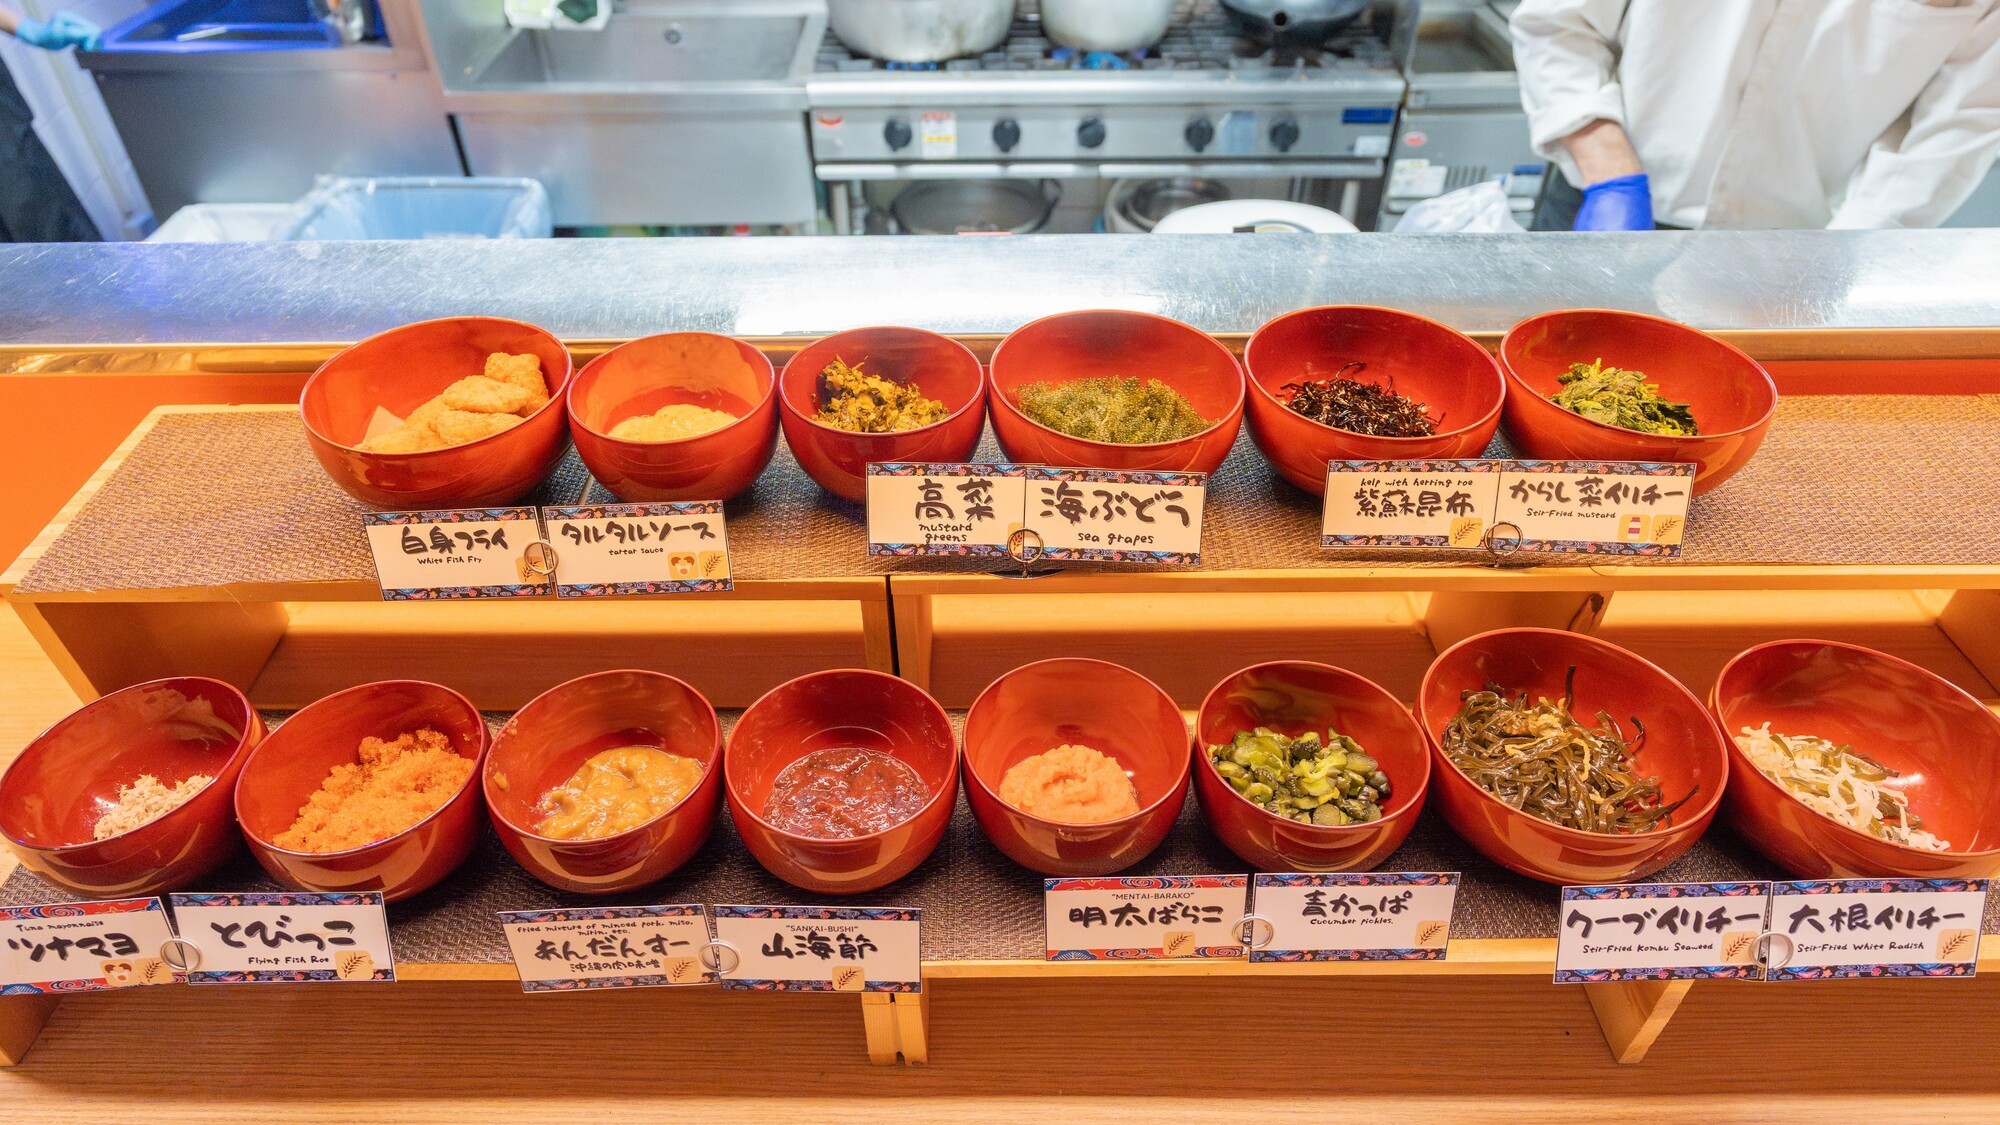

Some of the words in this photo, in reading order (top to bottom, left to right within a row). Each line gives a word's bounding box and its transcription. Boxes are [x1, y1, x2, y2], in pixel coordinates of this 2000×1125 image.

[1360, 478, 1380, 487] kelp
[1385, 478, 1408, 486] with
[1413, 478, 1452, 487] herring
[1509, 476, 1684, 507] からし菜イリチー
[915, 478, 995, 522] 高菜
[1040, 481, 1190, 526] 海ぶどう
[1353, 488, 1475, 518] 紫蘇昆布
[561, 521, 716, 546] タルタルソース
[919, 522, 973, 532] mustard
[925, 532, 967, 543] greens
[1078, 532, 1100, 543] sea
[1108, 533, 1155, 546] grapes
[402, 526, 508, 554] 白身フライ
[608, 548, 637, 556] tartar
[417, 557, 443, 565] White
[468, 555, 482, 564] Fry
[1069, 902, 1225, 928] 明太ばらこ
[1302, 889, 1413, 917] 青かっぱ
[16, 923, 43, 932] Tuna
[47, 920, 104, 930] mayonnaise
[602, 921, 637, 929] minced
[1567, 905, 1761, 938] クーブイリチー
[1788, 903, 1966, 934] 大根イリチー
[210, 915, 356, 951] とびっこ
[761, 930, 878, 960] 山海節
[7, 932, 140, 962] ツナマヨ
[534, 933, 690, 960] あんだんすー
[1674, 942, 1714, 951] Seaweed
[1889, 942, 1925, 950] Radish
[248, 956, 280, 965] Flying
[285, 956, 306, 964] Fish
[311, 956, 329, 964] Roe
[569, 959, 661, 973] 沖縄の肉味噌
